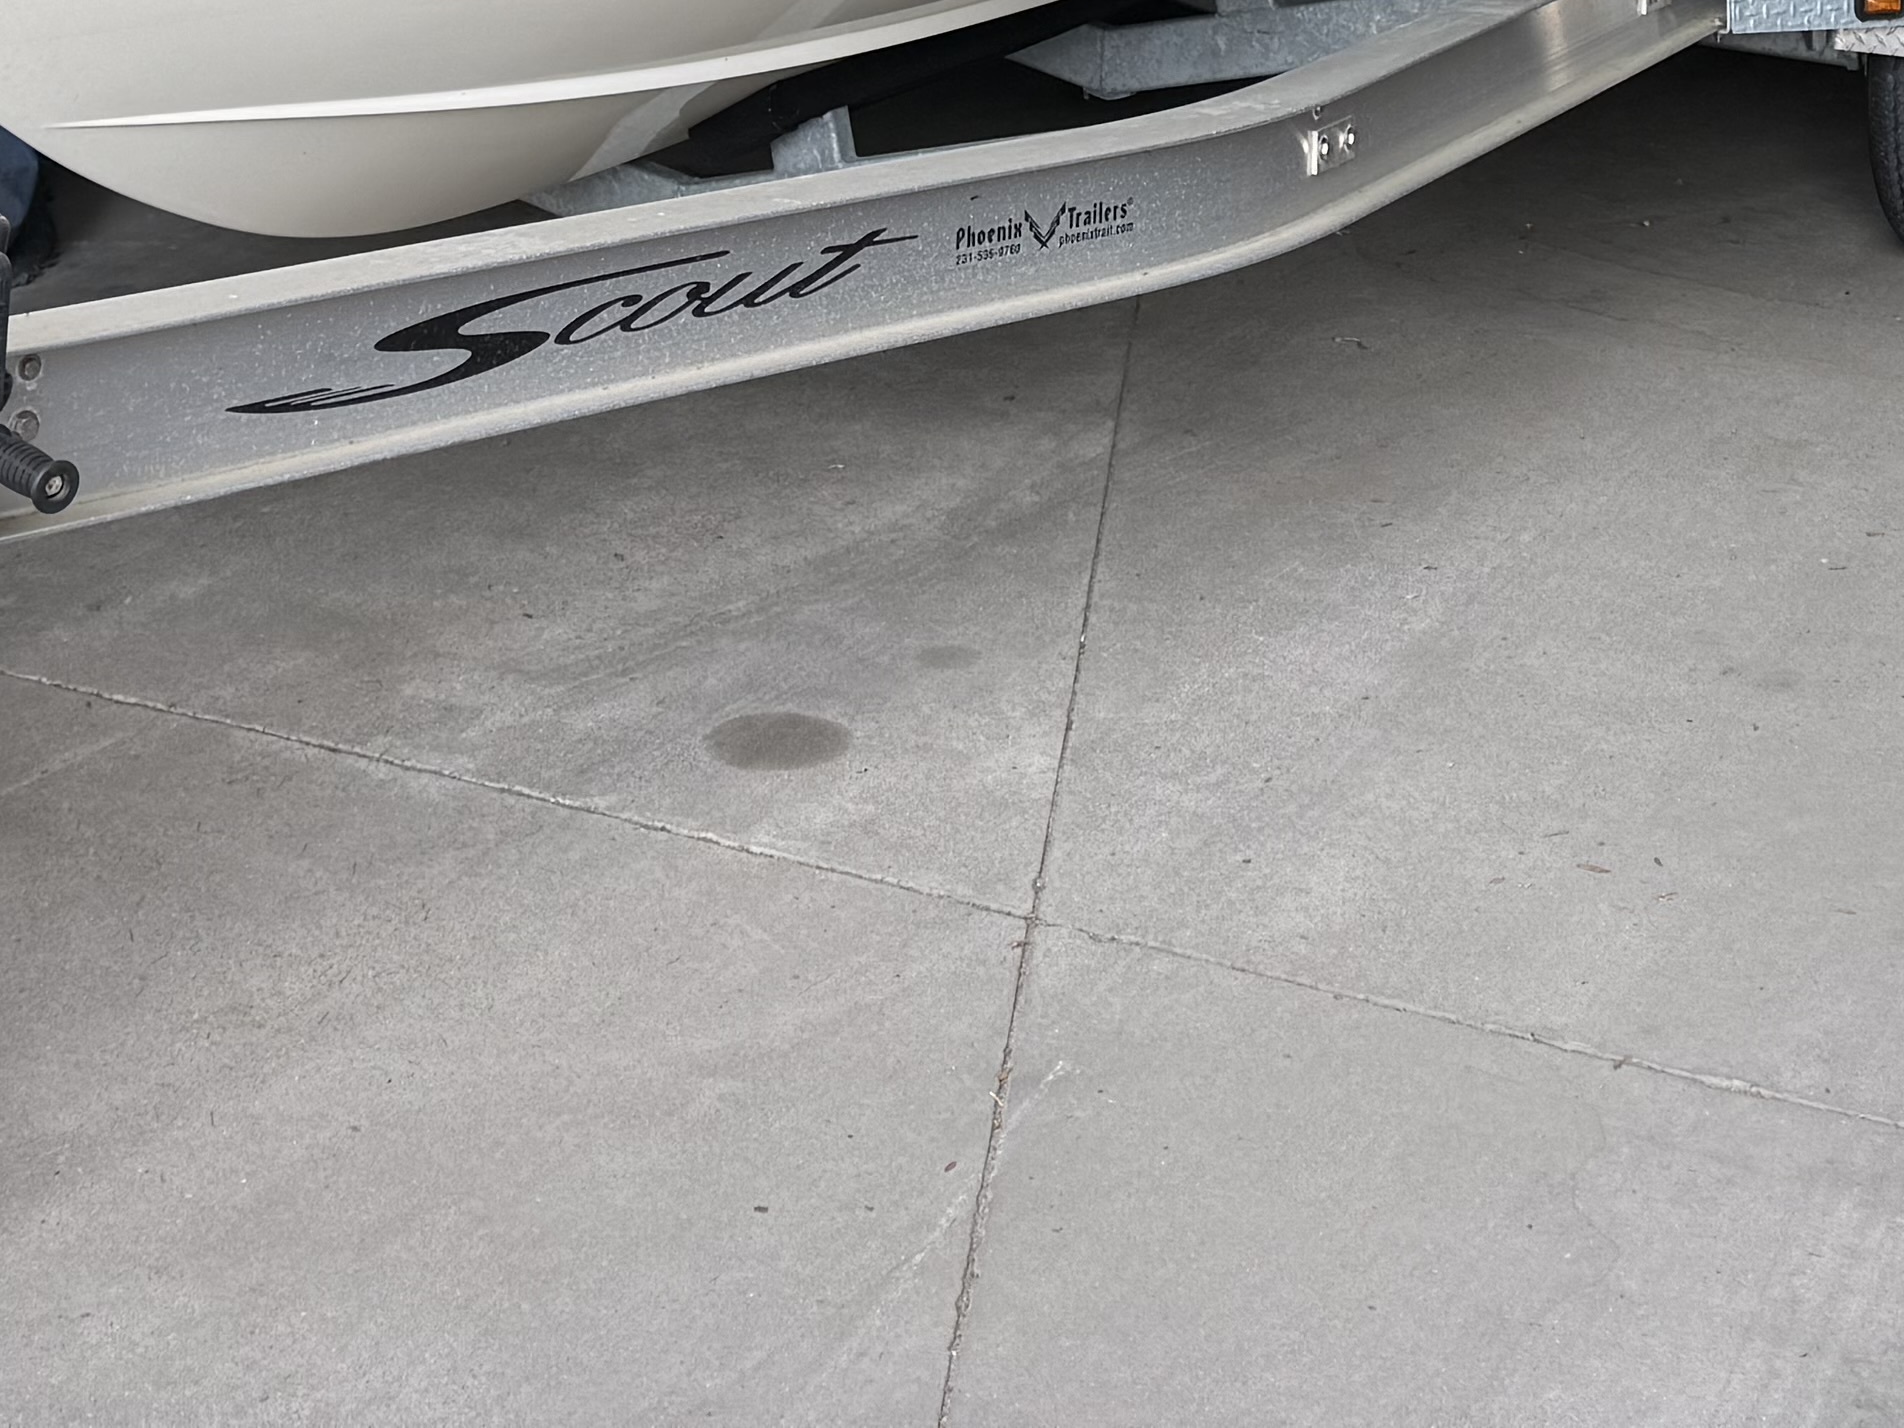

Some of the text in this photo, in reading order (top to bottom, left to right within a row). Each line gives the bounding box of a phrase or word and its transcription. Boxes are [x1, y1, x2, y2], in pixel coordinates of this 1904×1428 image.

[955, 201, 1128, 250] Phoenix Trailers
[224, 227, 918, 415] Scout
